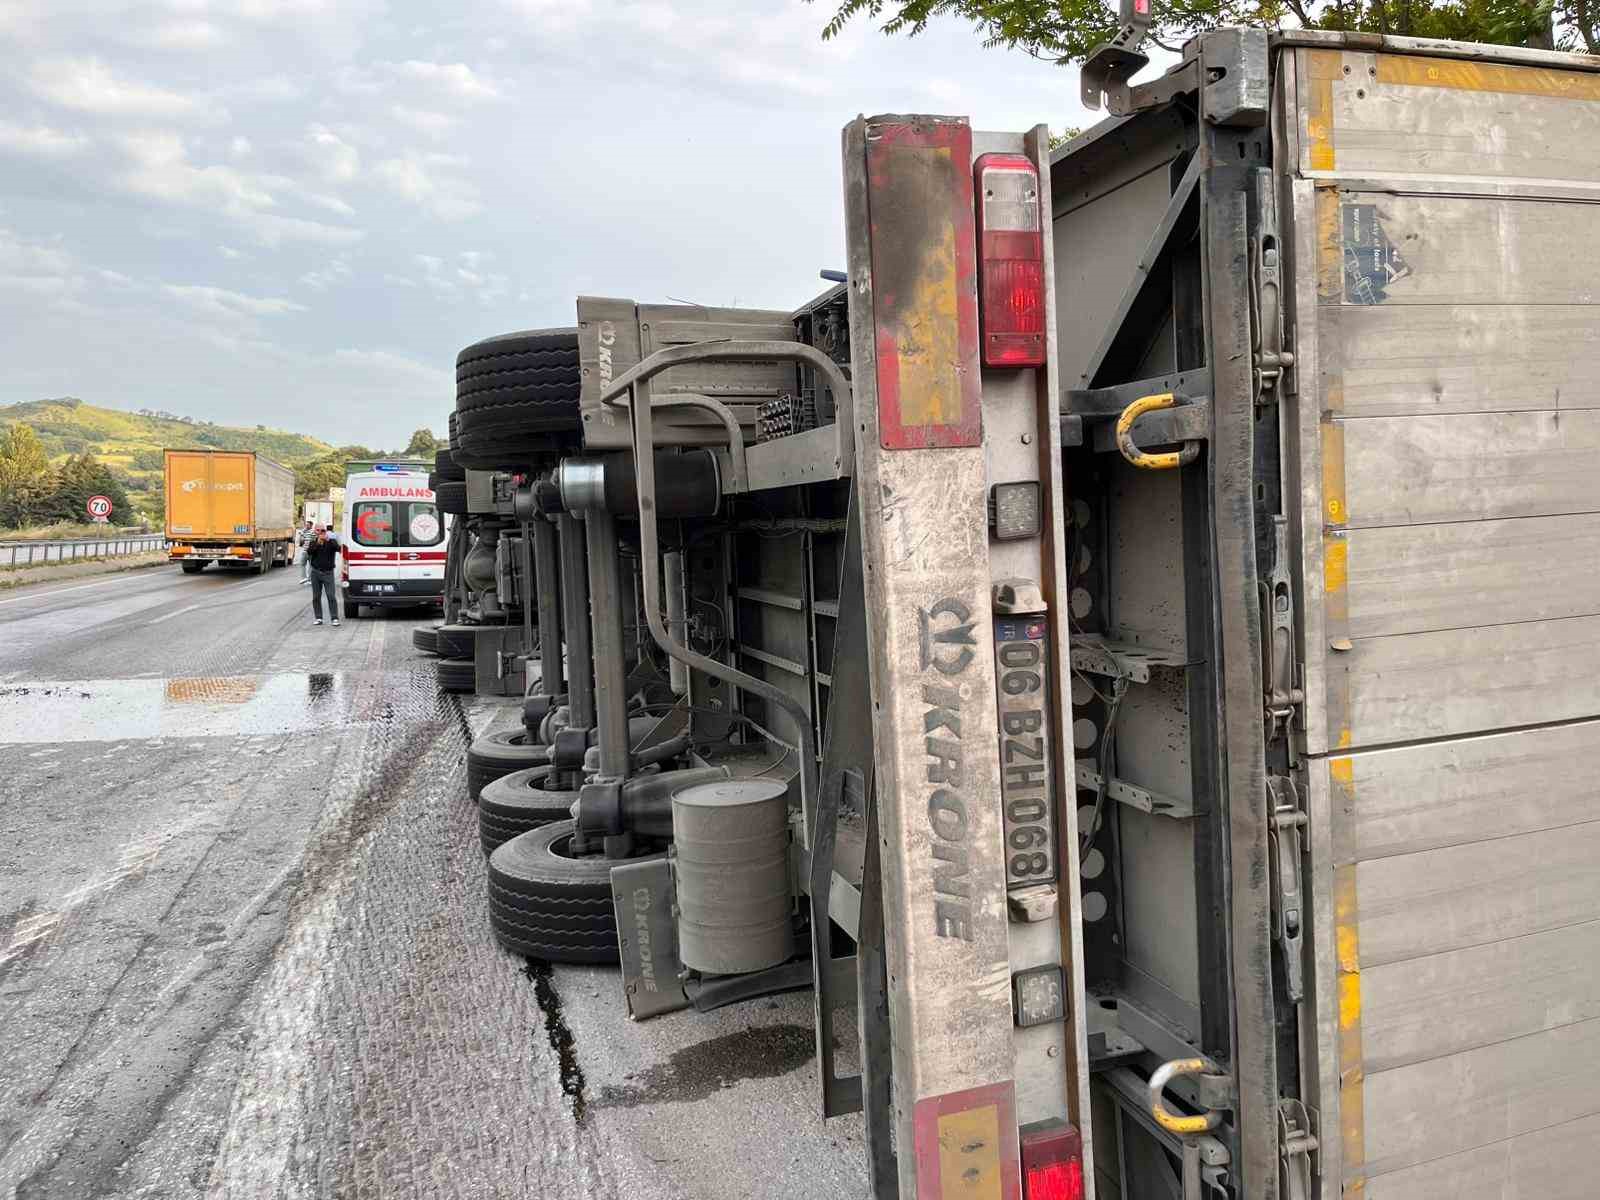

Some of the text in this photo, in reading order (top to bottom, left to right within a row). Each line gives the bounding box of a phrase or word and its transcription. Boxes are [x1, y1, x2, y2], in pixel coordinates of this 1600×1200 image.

[93, 502, 107, 512] 70
[360, 487, 433, 498] AMBULANS
[999, 624, 1048, 877] TR 06 BZH 068
[921, 684, 974, 943] KRONE
[635, 914, 658, 993] KRONE
